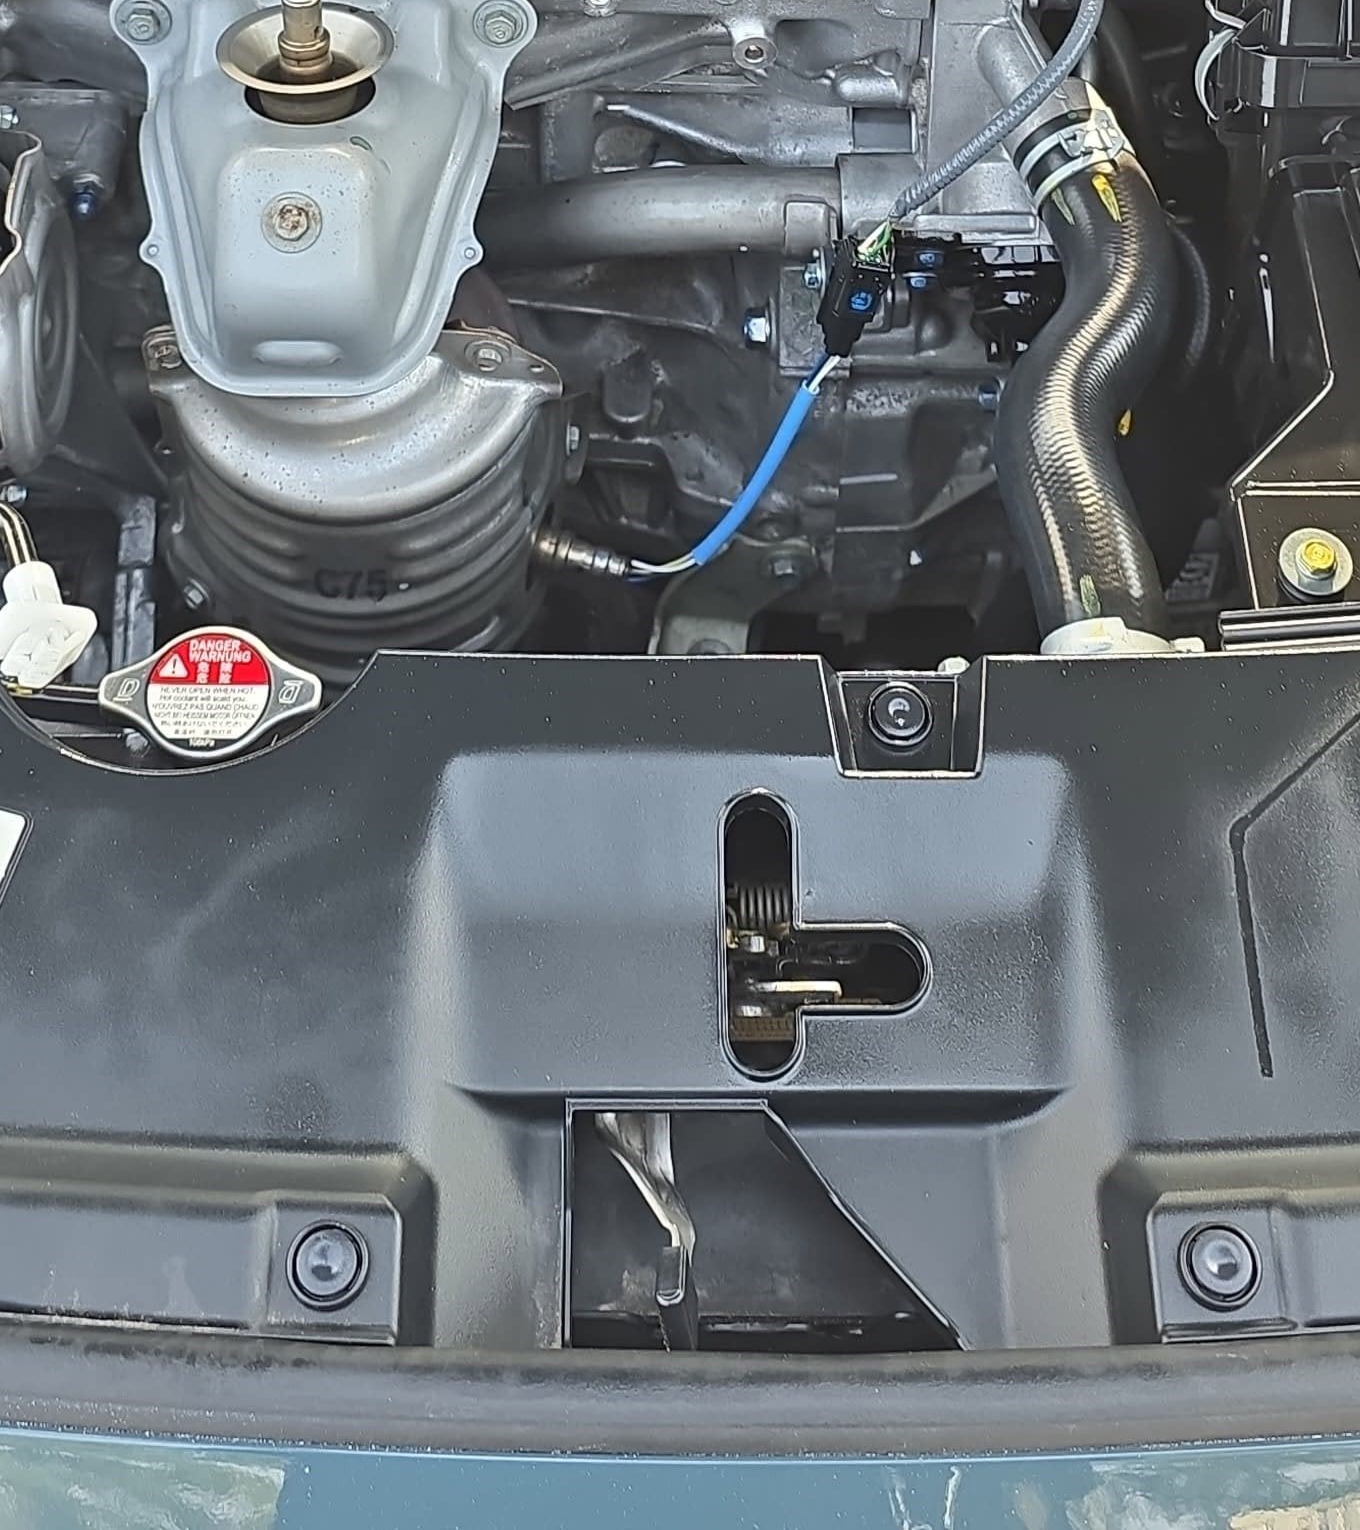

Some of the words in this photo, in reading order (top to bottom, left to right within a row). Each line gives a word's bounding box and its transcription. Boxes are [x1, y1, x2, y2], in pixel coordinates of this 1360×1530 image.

[189, 638, 241, 652] DANGER
[189, 649, 252, 663] WARNUNG
[188, 686, 211, 695] OPEN
[212, 686, 236, 695] WHEN
